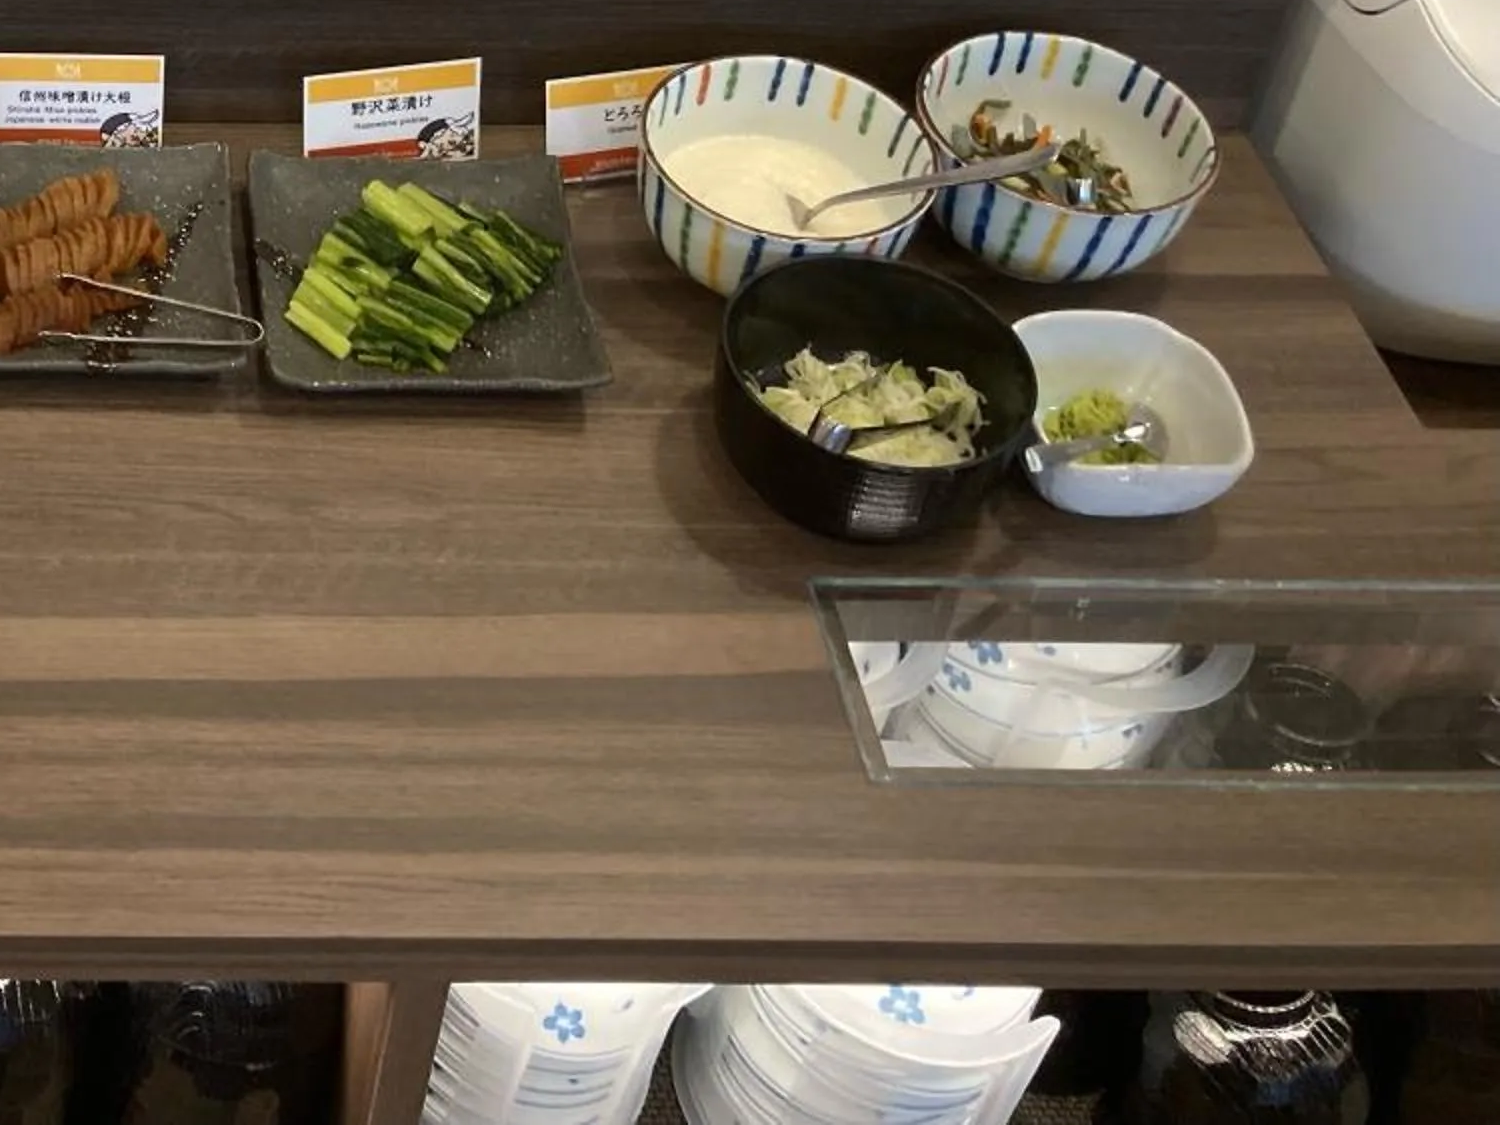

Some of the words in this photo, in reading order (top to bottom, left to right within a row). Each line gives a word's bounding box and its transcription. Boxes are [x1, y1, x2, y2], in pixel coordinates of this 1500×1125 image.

[19, 89, 132, 105] 信州味噌漬け大根
[351, 93, 433, 116] 野沢菜漬け
